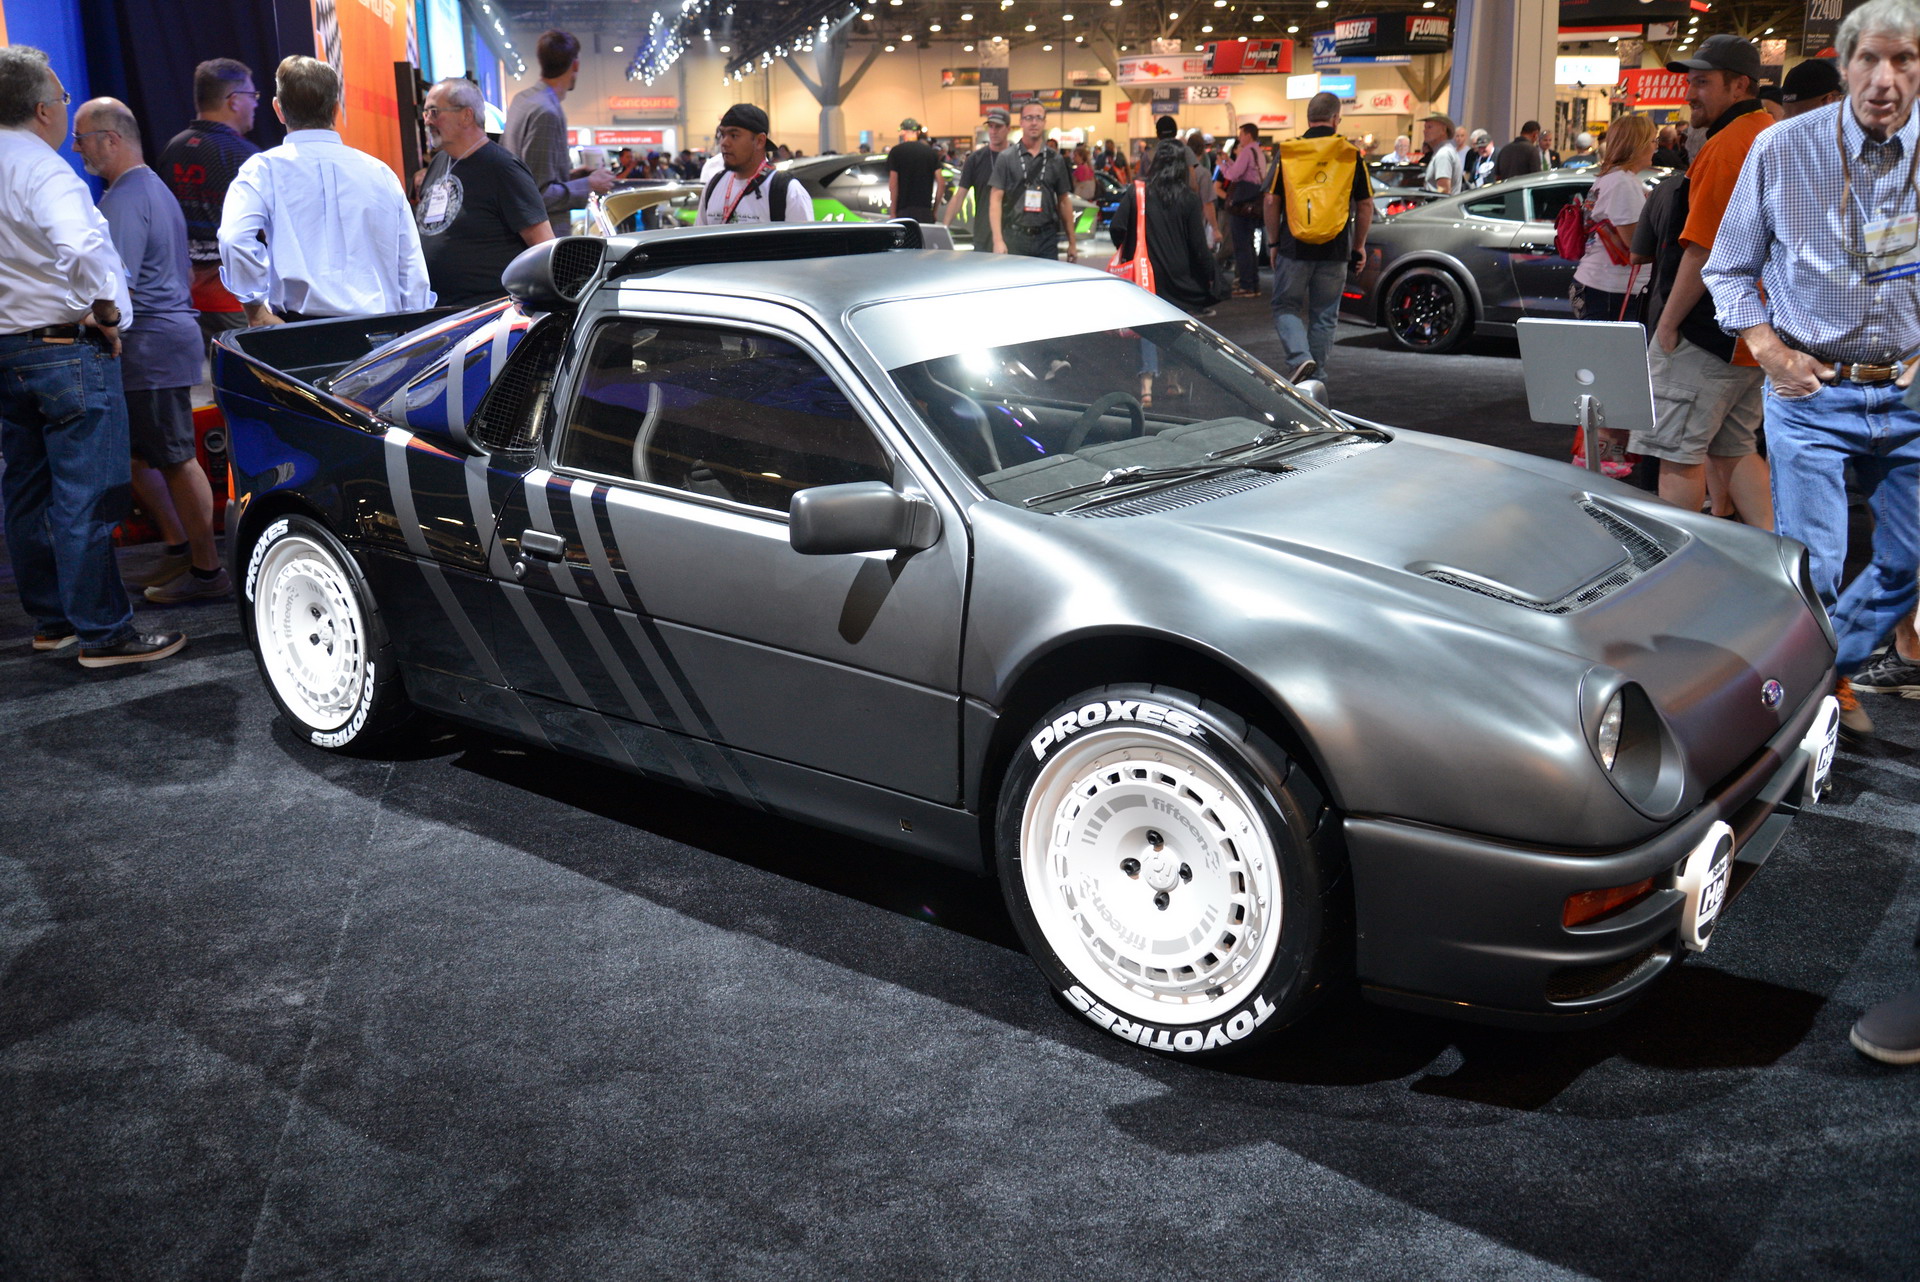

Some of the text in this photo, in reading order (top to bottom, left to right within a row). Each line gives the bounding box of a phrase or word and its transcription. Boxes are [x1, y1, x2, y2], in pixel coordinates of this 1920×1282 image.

[1247, 50, 1279, 60] HURST
[1638, 73, 1685, 88] CHARGE
[1637, 86, 1687, 99] FORWAR
[246, 519, 289, 603] PROXES
[1031, 700, 1205, 761] PROXES
